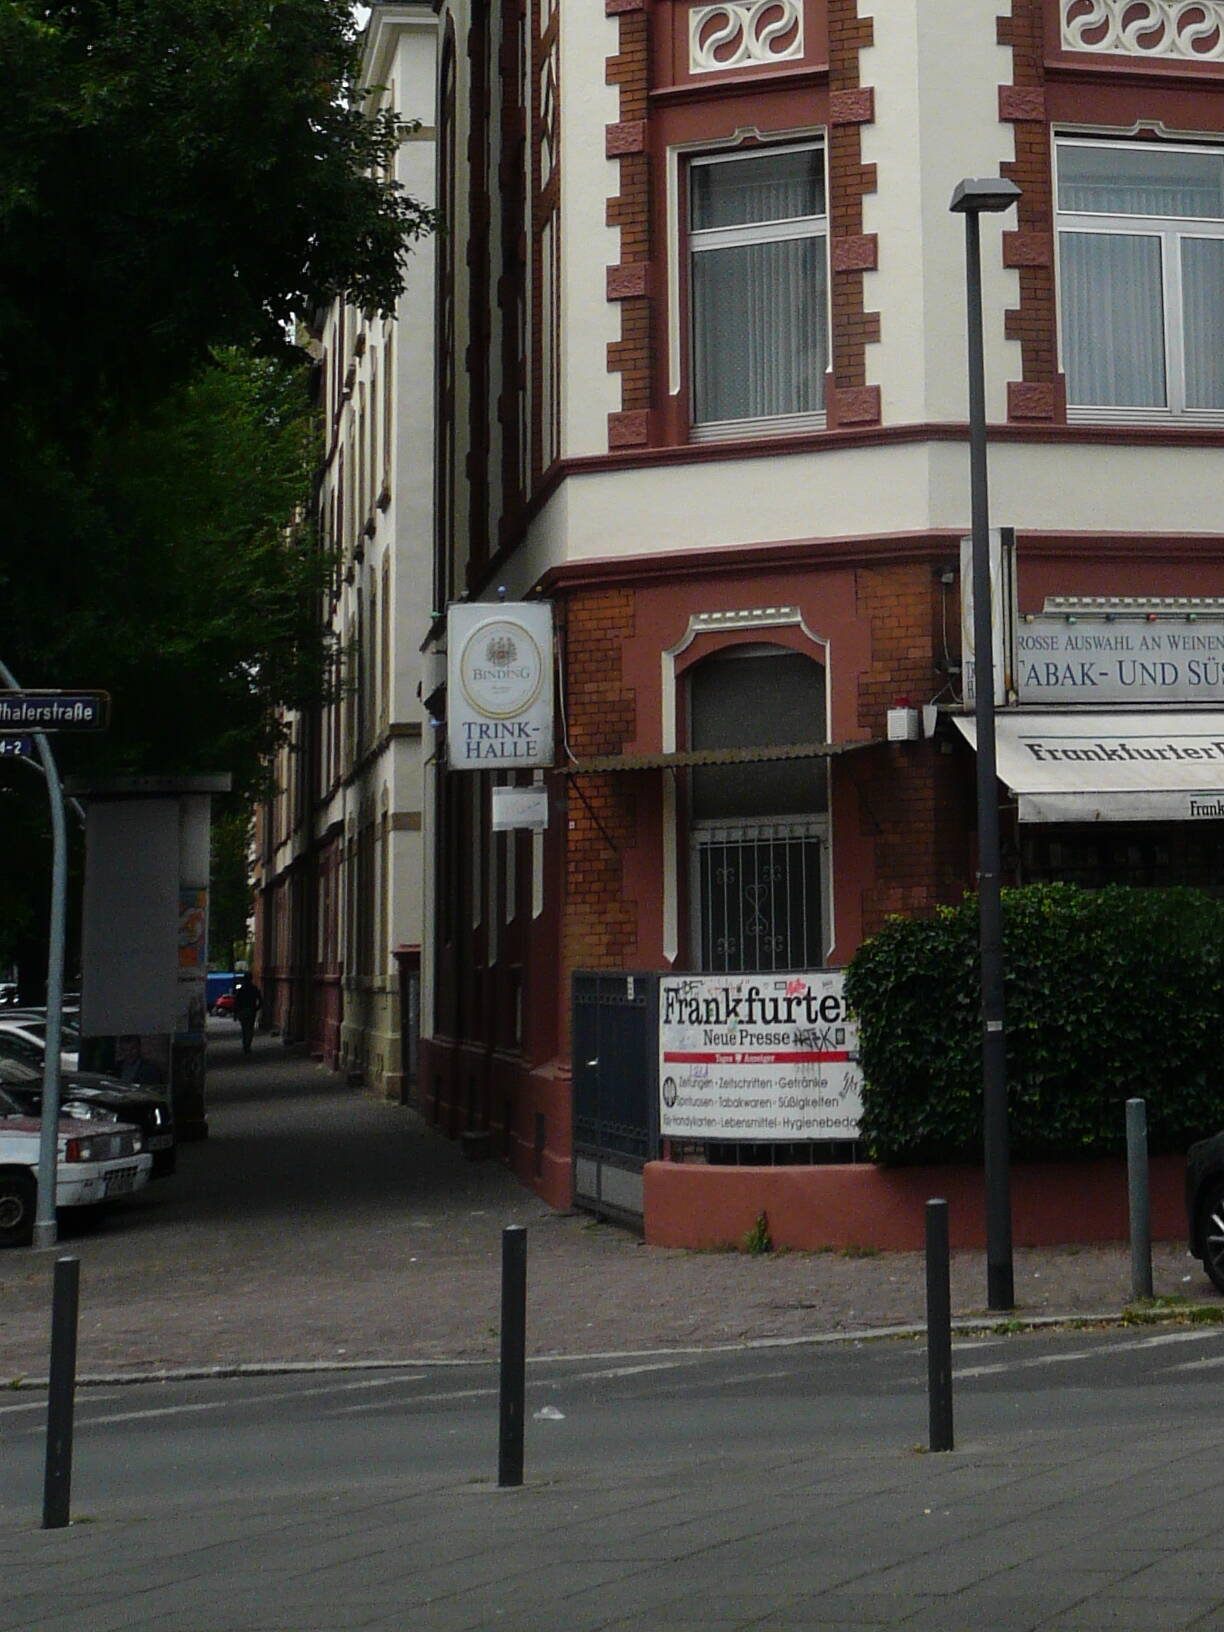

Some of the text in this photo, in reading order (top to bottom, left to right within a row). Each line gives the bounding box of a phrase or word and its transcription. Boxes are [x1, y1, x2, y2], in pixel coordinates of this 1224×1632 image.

[1065, 635, 1133, 651] AUSWAHL
[1140, 635, 1162, 650] AN
[472, 668, 531, 681] BINDING
[1116, 659, 1178, 687] UND
[462, 721, 541, 740] TRINK-
[465, 740, 538, 759] HALLE
[703, 1029, 737, 1046] Neue
[739, 1028, 790, 1046] Presse
[719, 1076, 773, 1089] Zeitschriften
[778, 1076, 828, 1089] Getränke
[719, 1095, 772, 1108] Tabakwaren
[778, 1095, 839, 1110] Süßigkeiten
[721, 1115, 777, 1128] Lebensmittel
[783, 1116, 858, 1131] Hygienebeda
